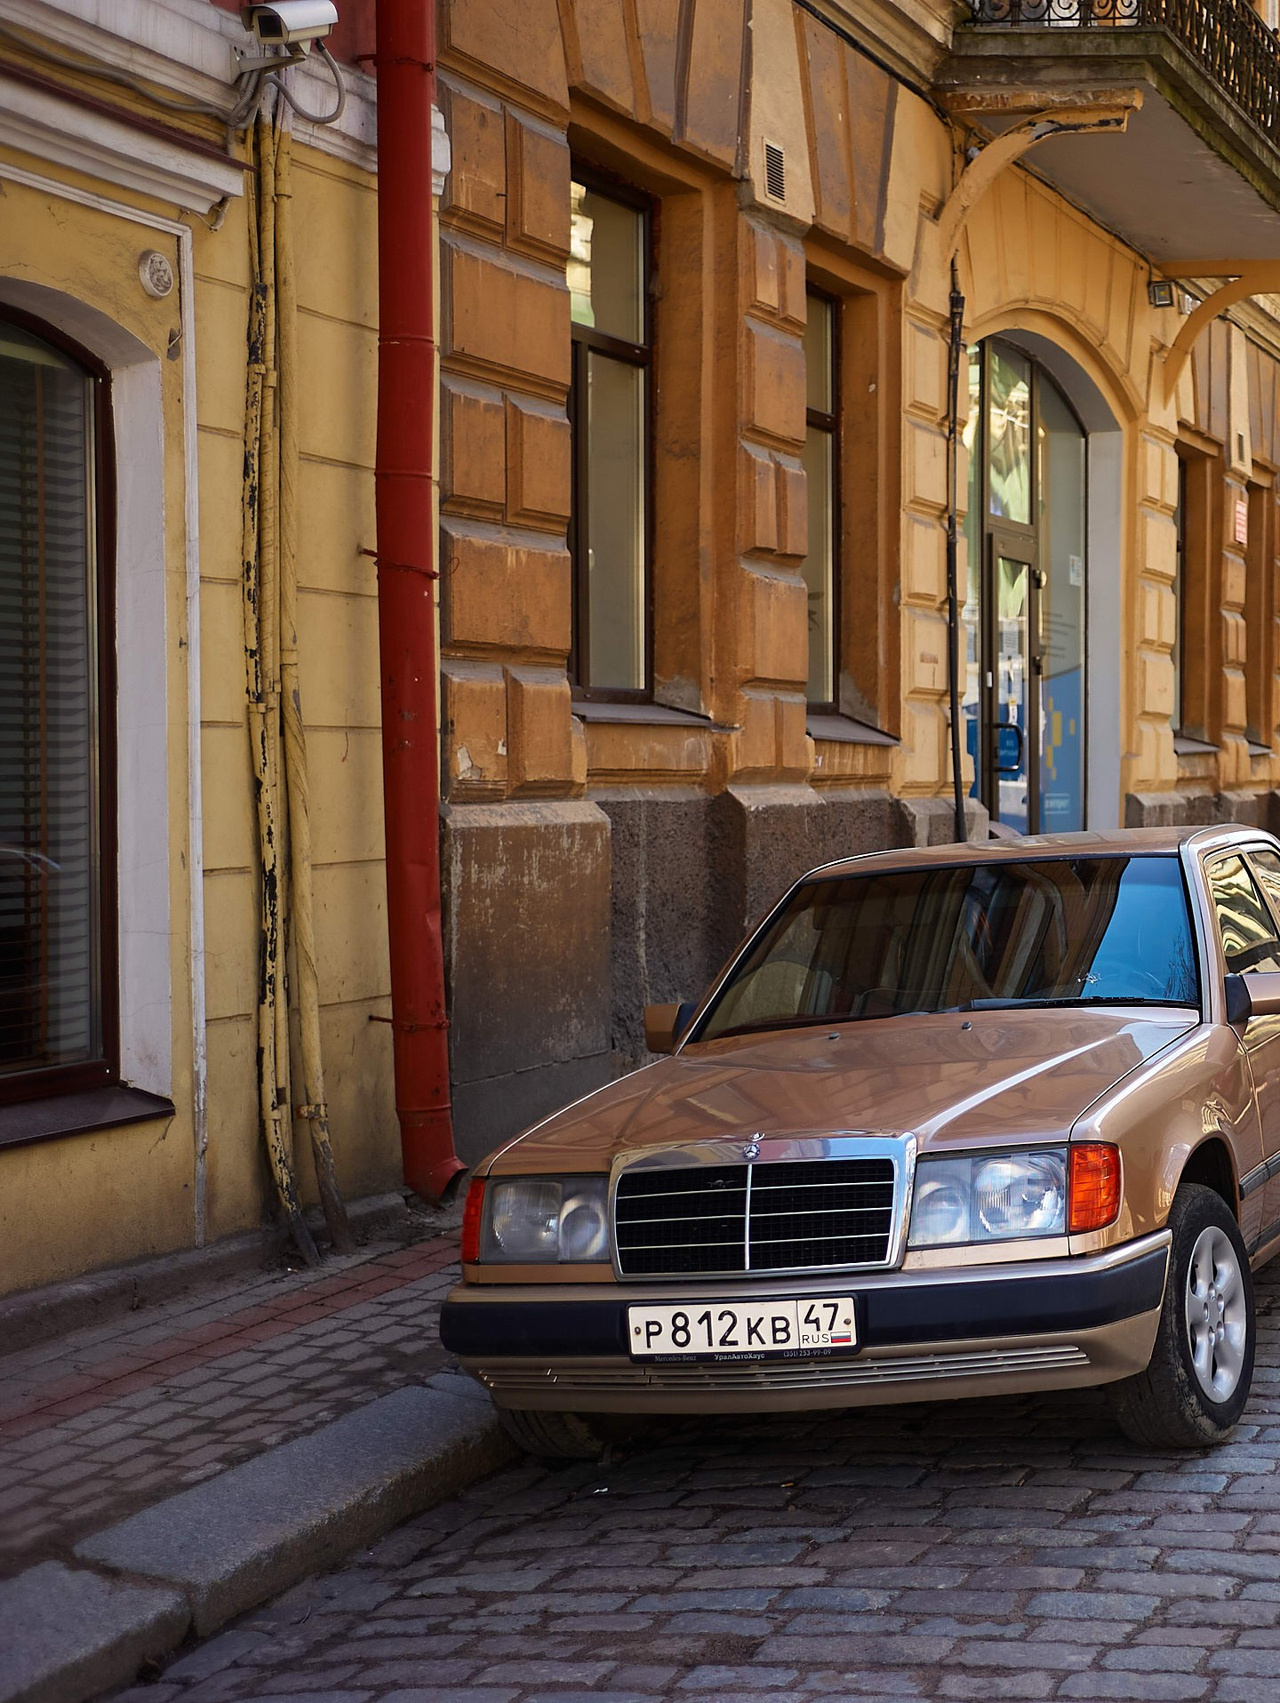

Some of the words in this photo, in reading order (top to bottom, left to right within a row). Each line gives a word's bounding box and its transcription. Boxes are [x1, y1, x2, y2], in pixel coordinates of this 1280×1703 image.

[803, 1302, 840, 1331] 47
[802, 1333, 830, 1345] RUS
[654, 1354, 697, 1362] Mercedes-Benz
[714, 1352, 765, 1361] УралАвтоХаус
